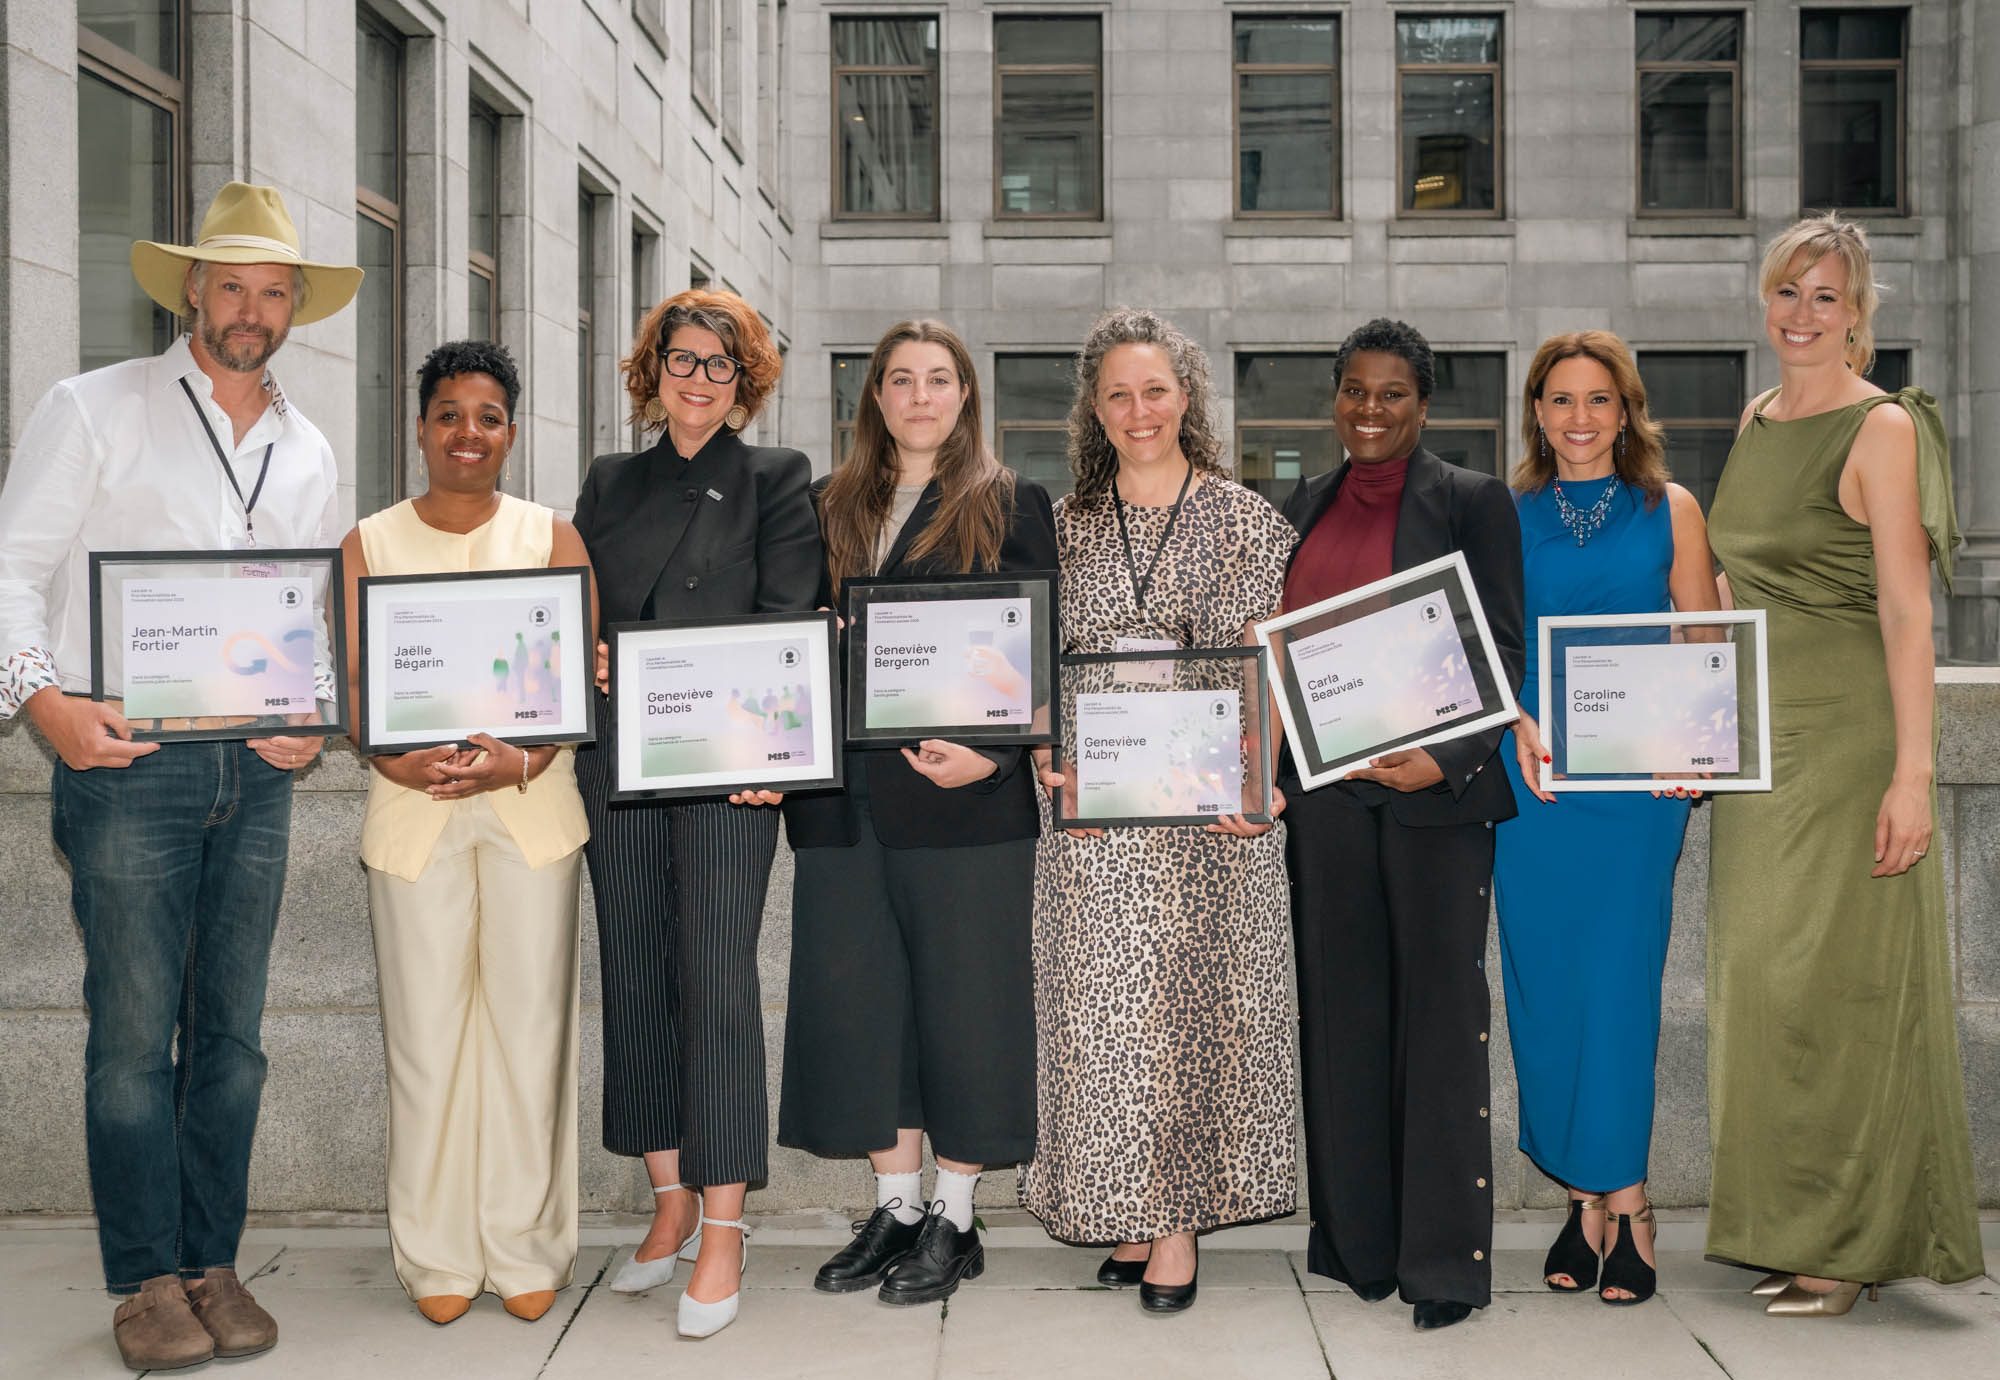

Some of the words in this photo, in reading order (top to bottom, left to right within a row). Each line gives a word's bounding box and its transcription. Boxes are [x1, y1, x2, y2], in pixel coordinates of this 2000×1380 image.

[132, 626, 217, 637] Jean-Martin
[133, 640, 179, 651] Fortier
[394, 646, 431, 656] Jaëlle
[875, 644, 936, 655] Geneviève
[395, 658, 443, 671] Bégarin
[875, 658, 929, 670] Bergeron
[1308, 674, 1339, 690] Carla
[1311, 676, 1364, 702] Beauvais
[1574, 689, 1625, 700] Caroline
[648, 689, 713, 702] Geneviève
[648, 703, 692, 715] Dubois
[1574, 702, 1608, 712] Codsi
[1085, 736, 1146, 747] Geneviève
[1085, 750, 1119, 762] Aubry
